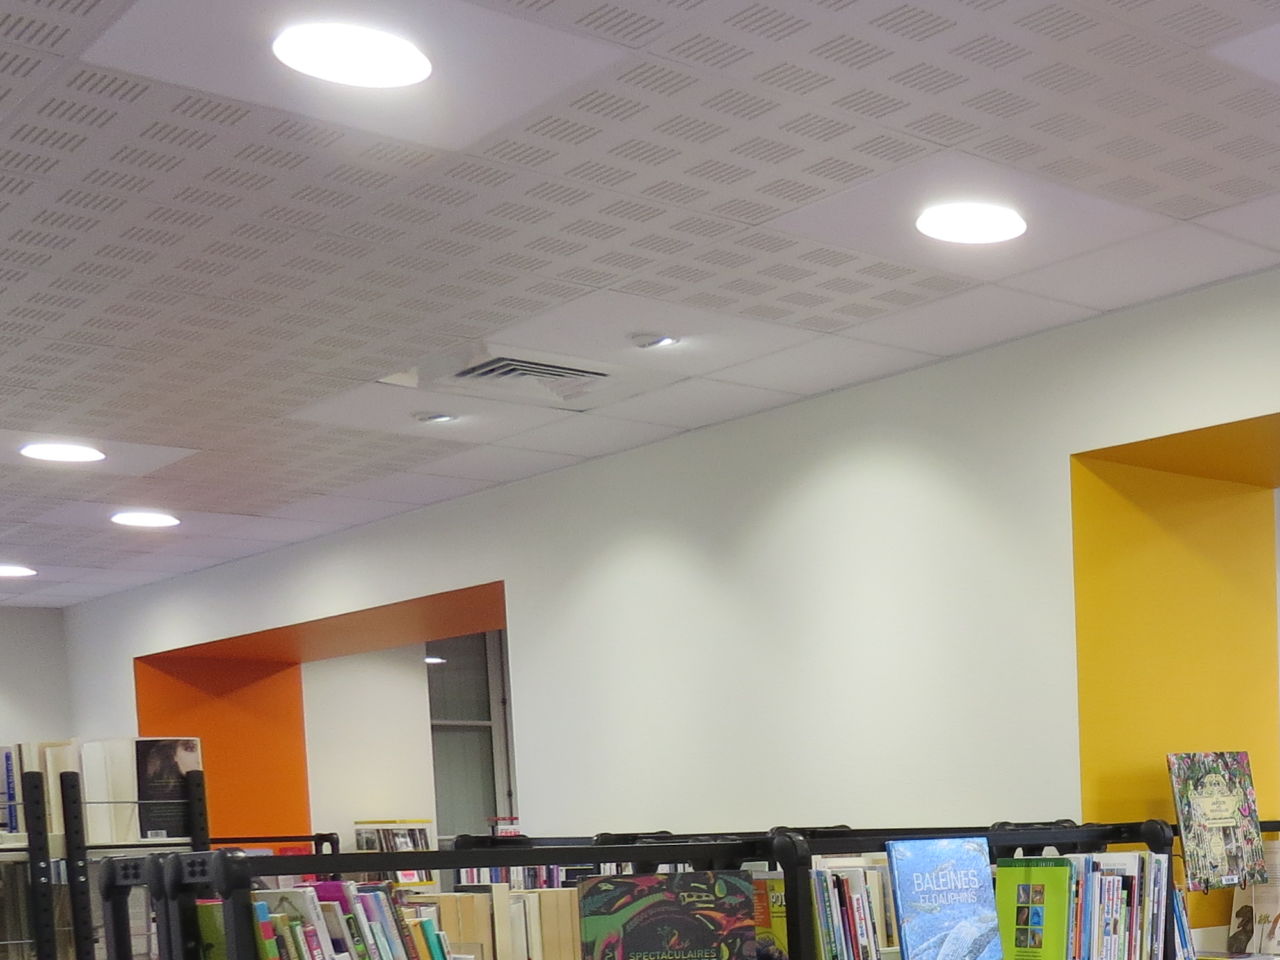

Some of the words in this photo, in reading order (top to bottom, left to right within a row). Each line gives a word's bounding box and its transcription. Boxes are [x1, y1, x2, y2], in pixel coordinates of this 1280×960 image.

[912, 869, 981, 893] BALEINES
[919, 894, 931, 906] ET
[931, 890, 978, 905] DAUPHINS
